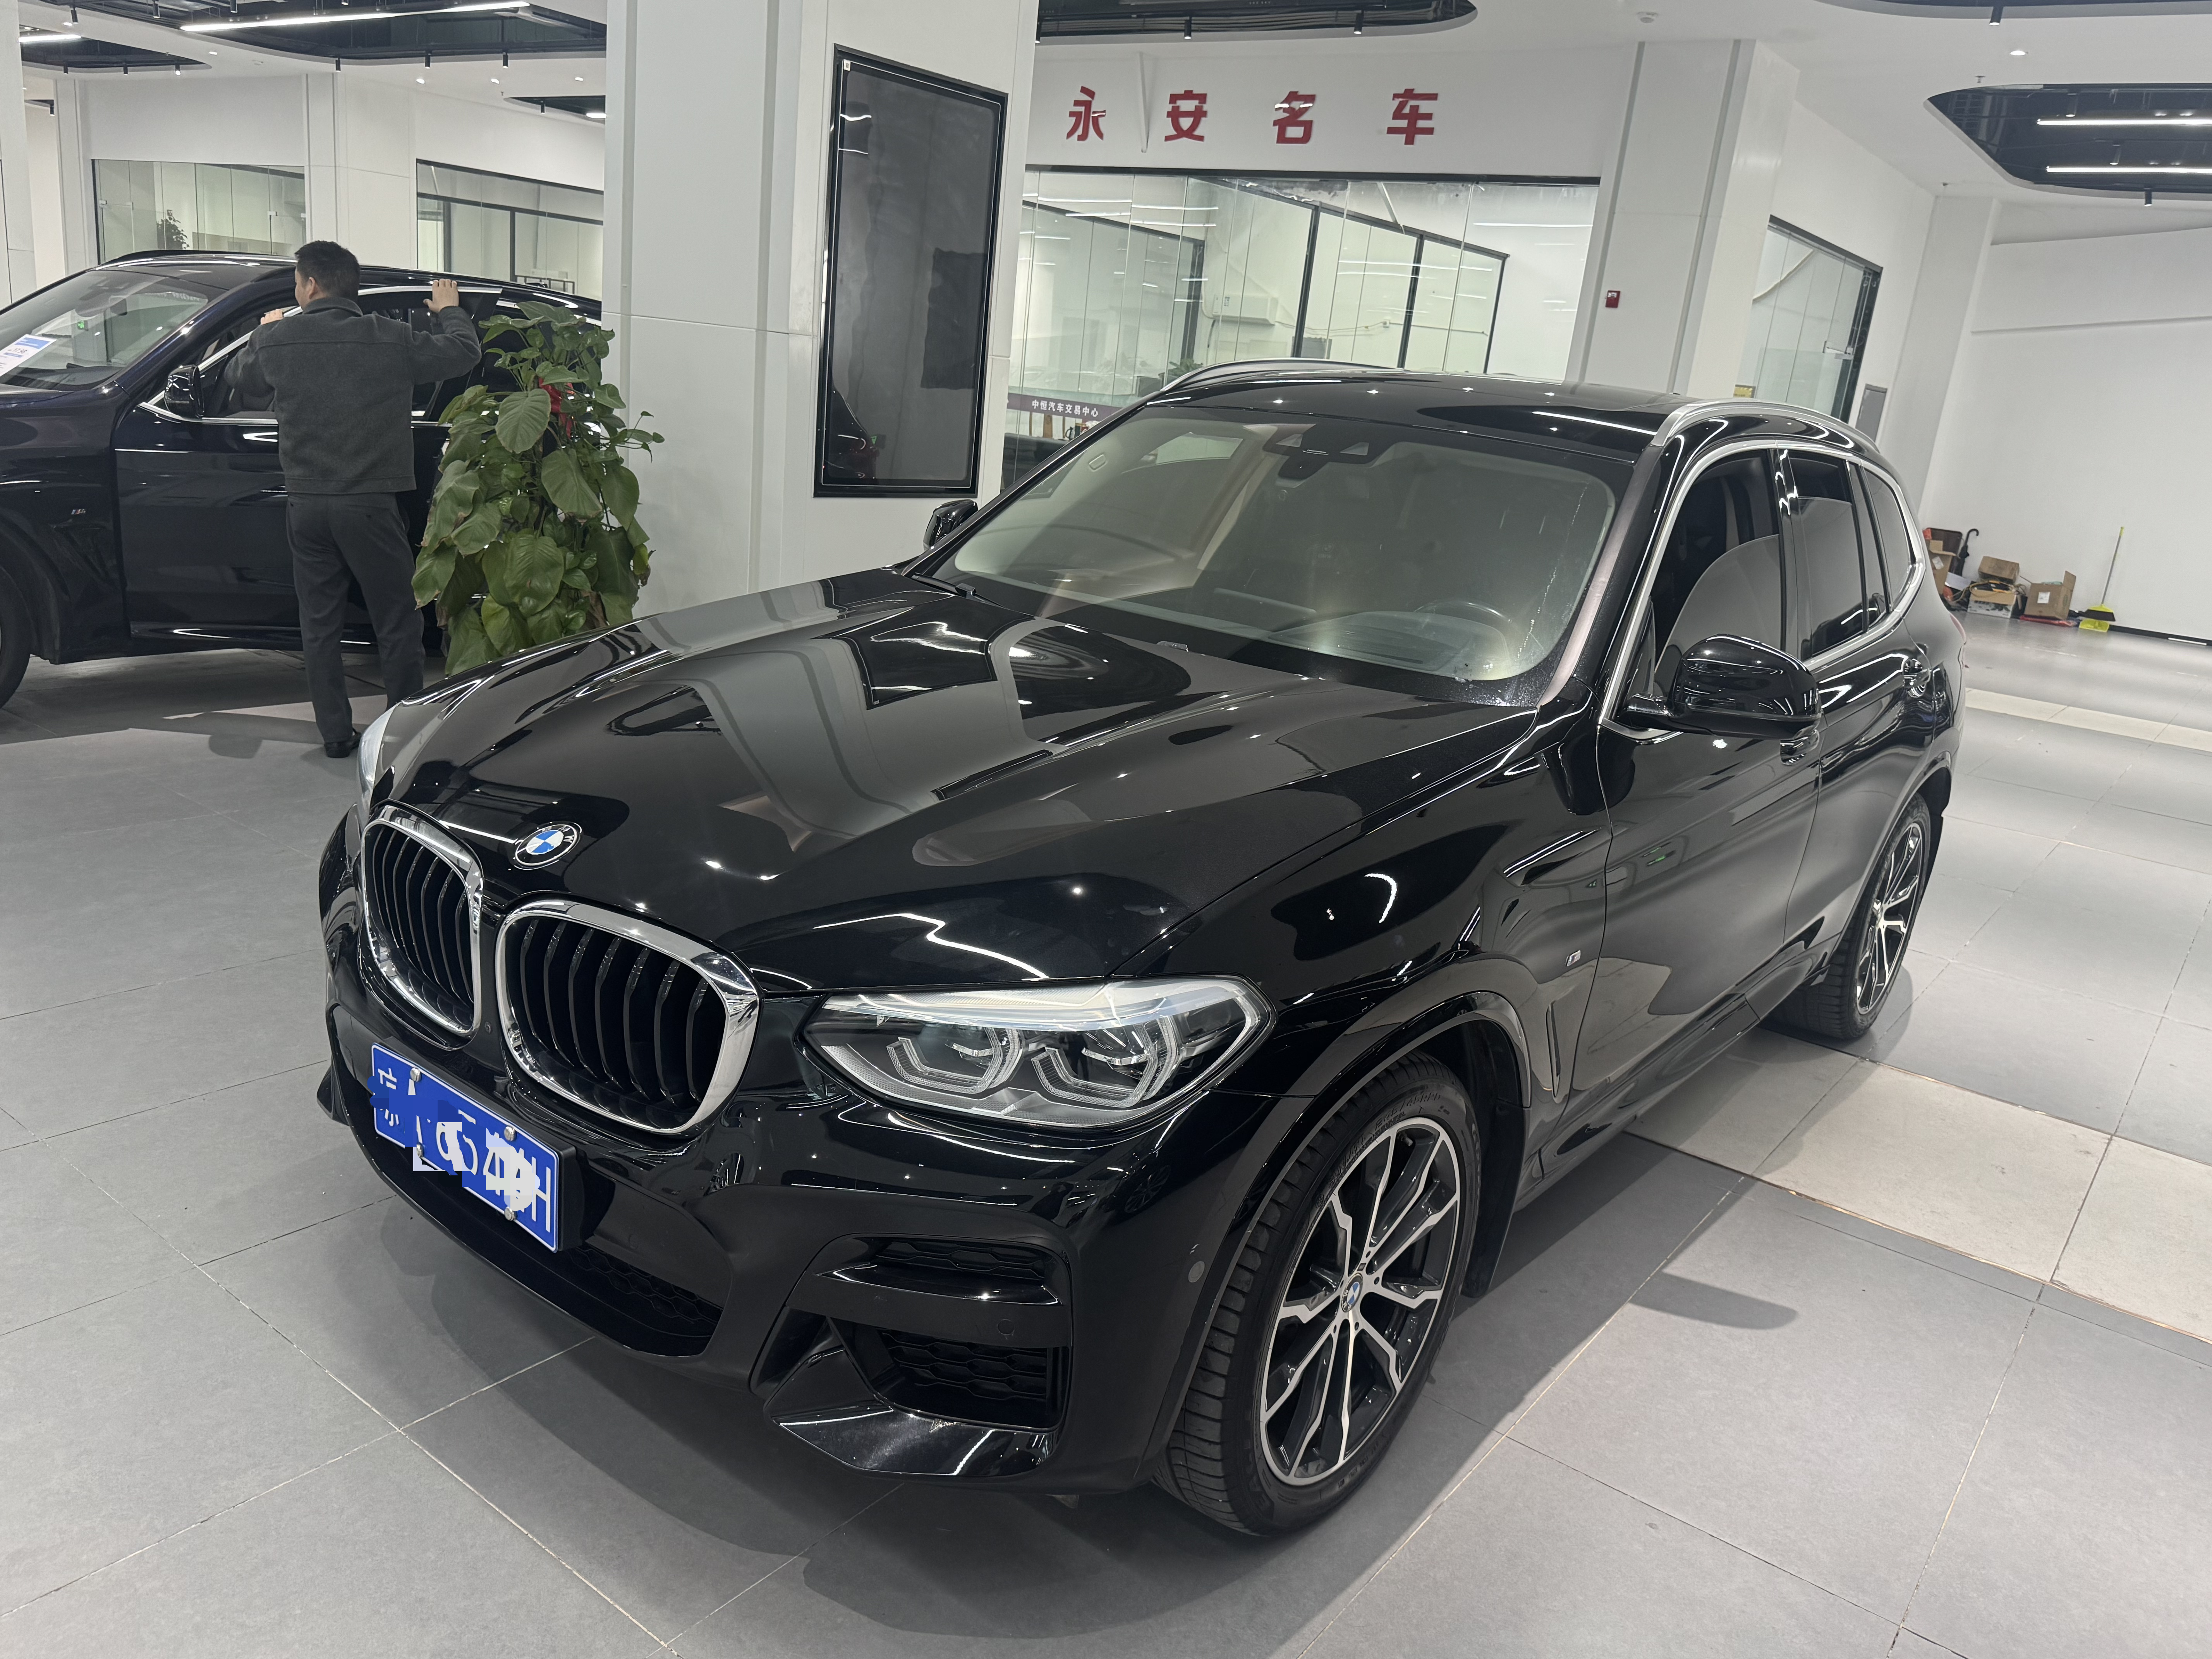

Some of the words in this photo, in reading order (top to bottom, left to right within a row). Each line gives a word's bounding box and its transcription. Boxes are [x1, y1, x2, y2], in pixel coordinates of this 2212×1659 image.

[1066, 86, 1439, 145] 永安名车
[1032, 399, 1099, 417] 中恒汽车交易中心
